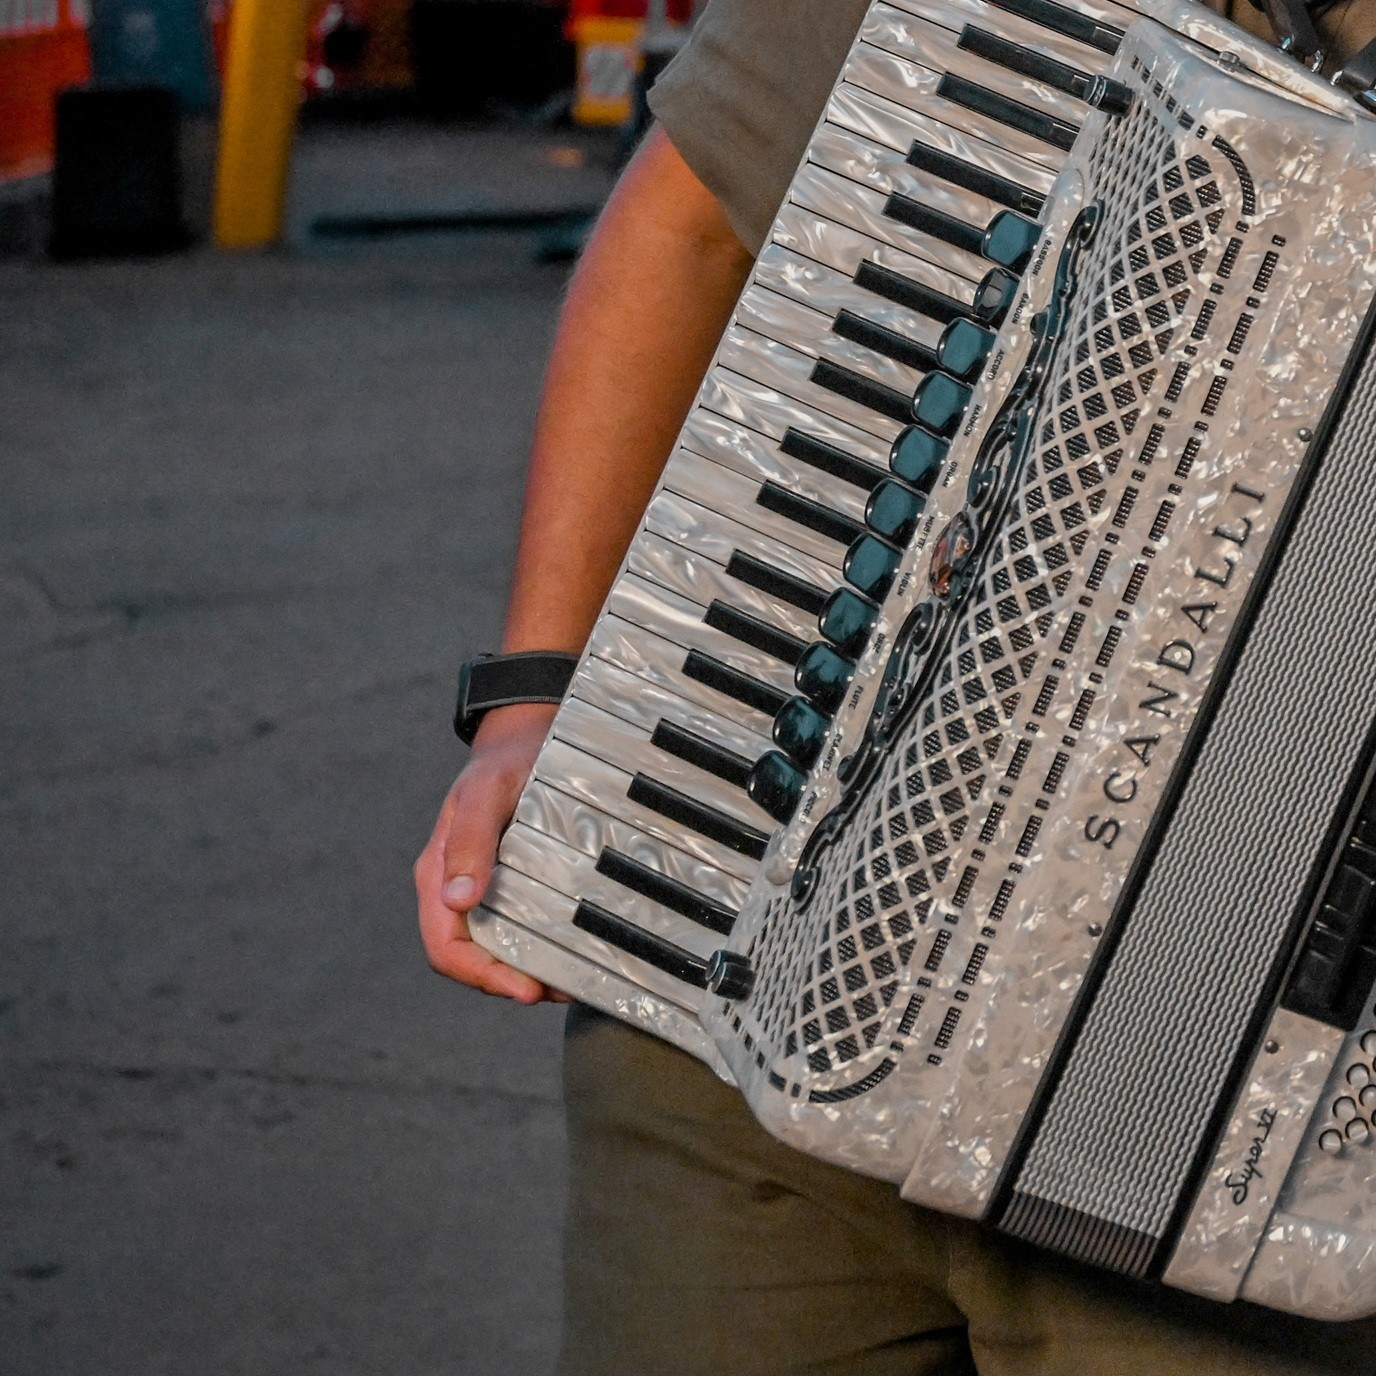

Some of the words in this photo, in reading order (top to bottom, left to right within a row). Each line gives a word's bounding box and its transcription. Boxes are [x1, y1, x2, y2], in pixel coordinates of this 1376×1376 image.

[1031, 239, 1052, 276] BASSOON
[988, 349, 1005, 381] ACCORD
[963, 404, 982, 437] HARMON
[941, 461, 958, 488] ORGAN
[896, 572, 912, 597] VIOLIN
[1084, 482, 1266, 849] SCANDALLI
[848, 685, 864, 710] FLUTE
[822, 733, 843, 771] CLARINET
[801, 790, 818, 825] PICCOO
[1225, 1134, 1265, 1205] Super
